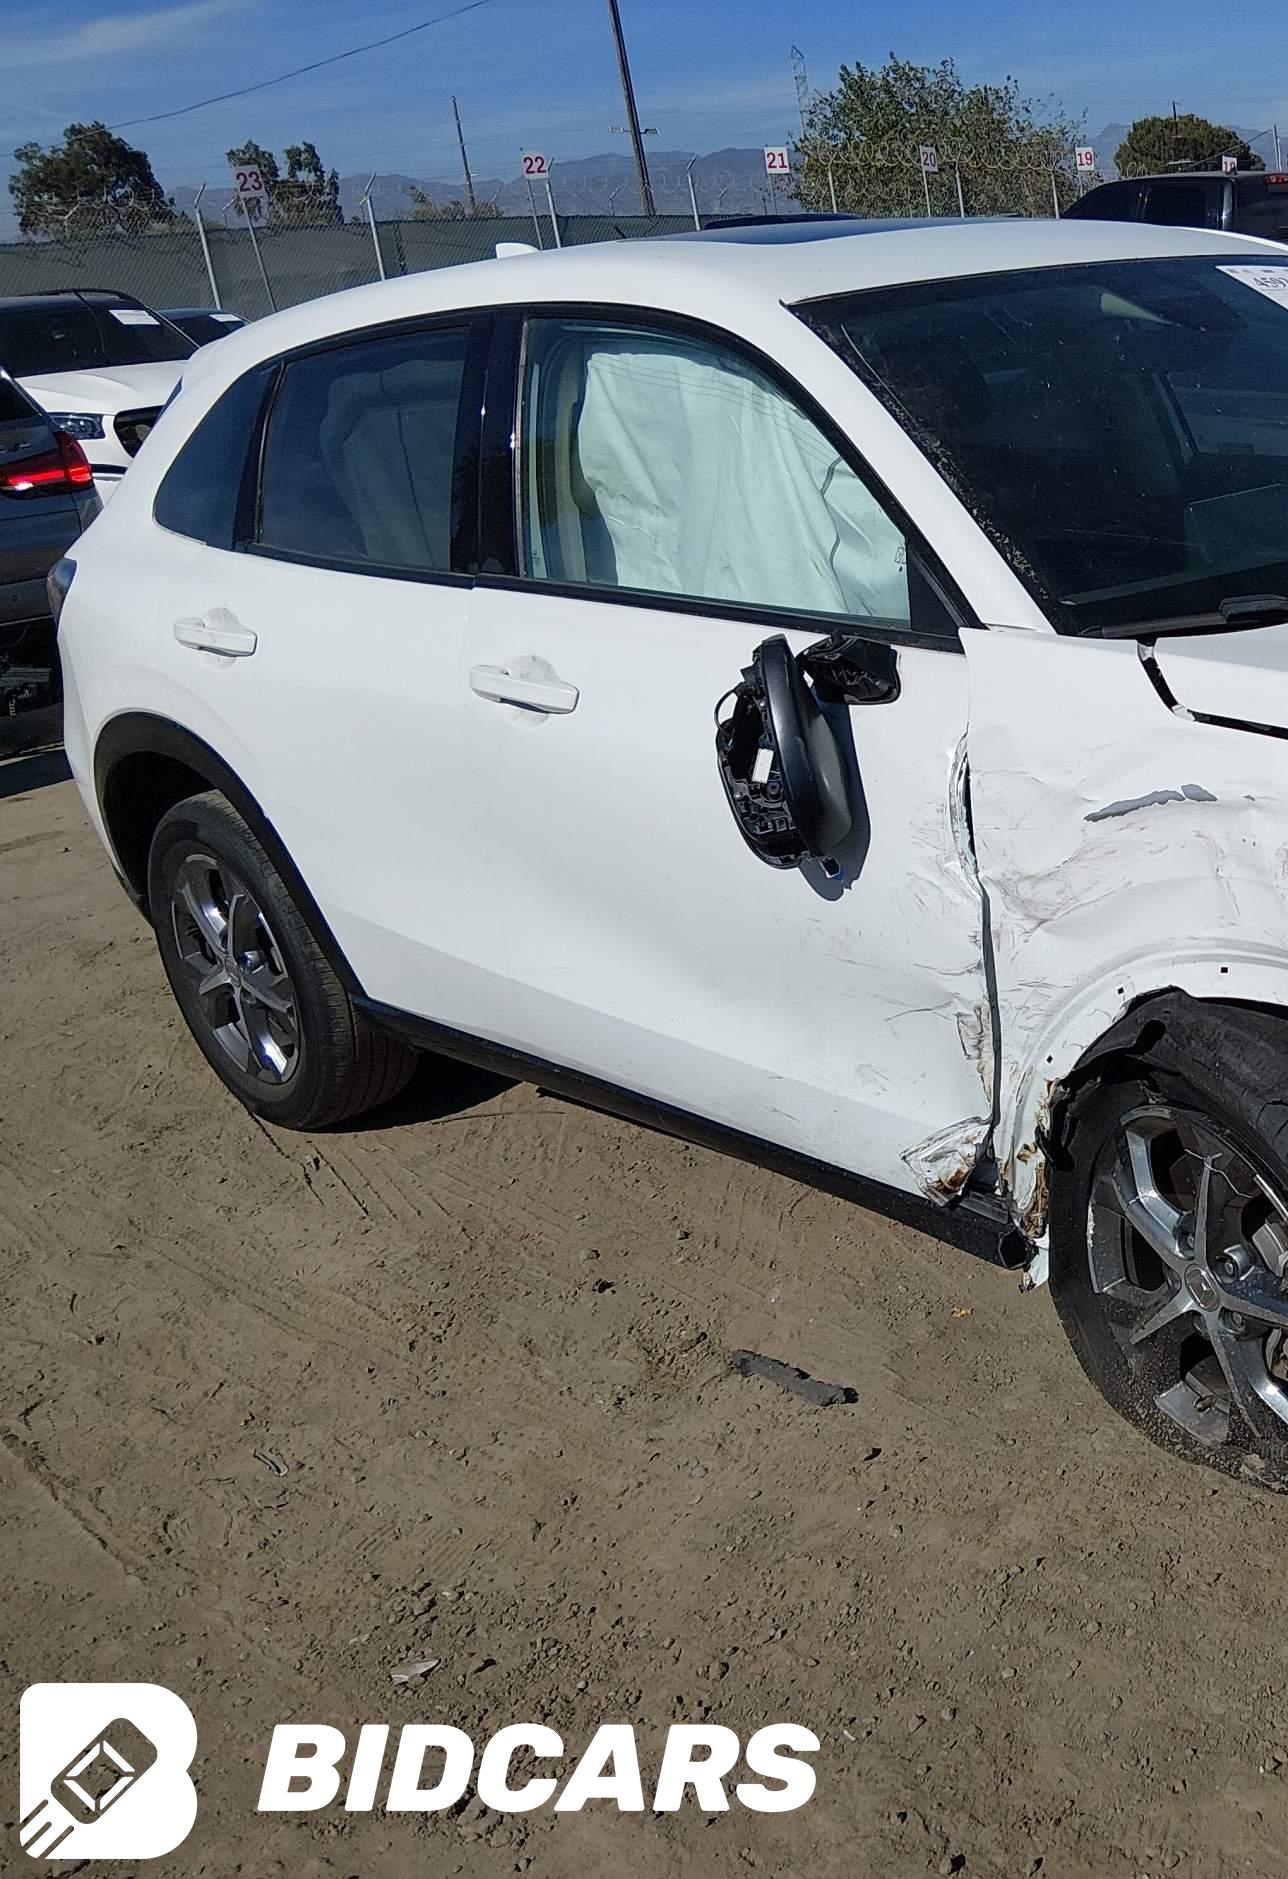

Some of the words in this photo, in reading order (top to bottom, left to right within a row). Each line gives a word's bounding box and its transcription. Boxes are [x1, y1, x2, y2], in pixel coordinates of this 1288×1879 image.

[523, 156, 547, 174] 22
[766, 151, 788, 169] 21
[922, 151, 936, 167] 20
[1077, 151, 1093, 167] 19
[236, 171, 262, 192] 23
